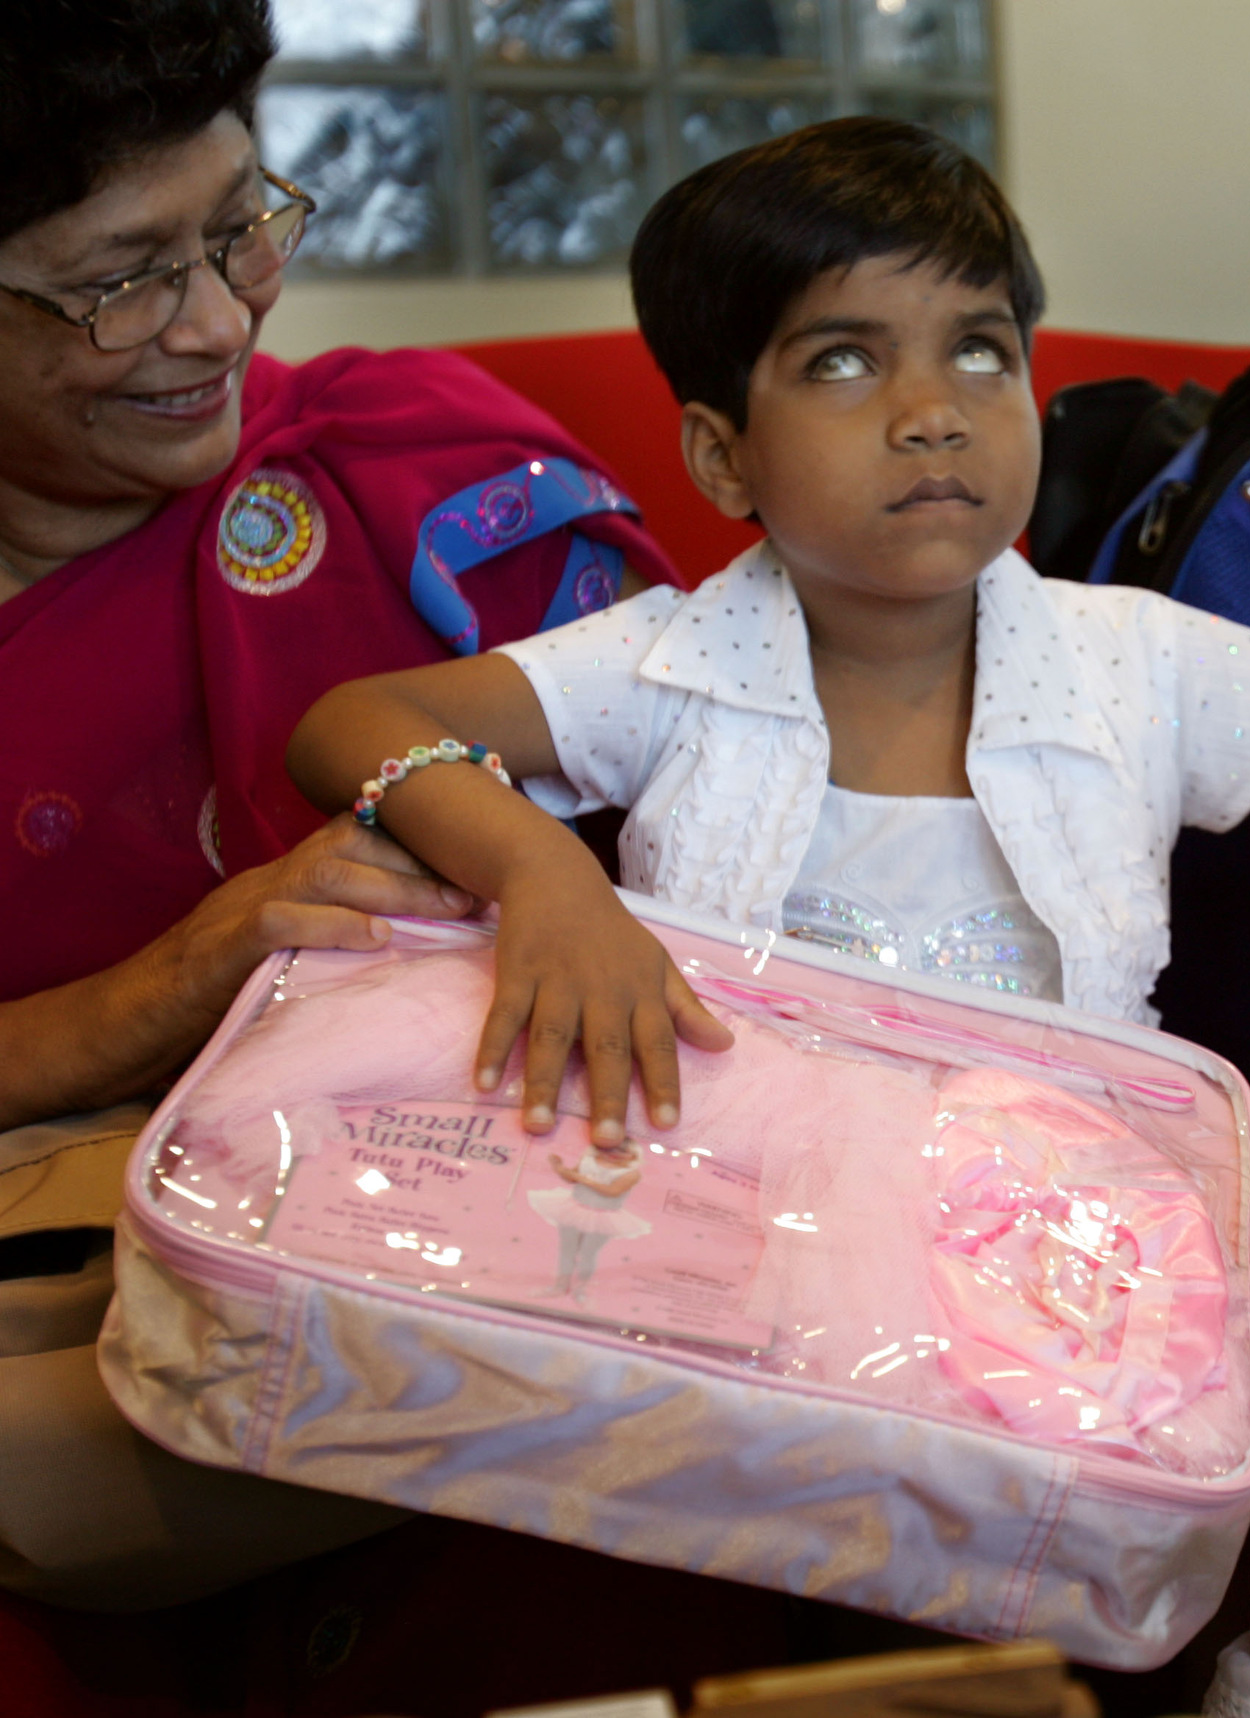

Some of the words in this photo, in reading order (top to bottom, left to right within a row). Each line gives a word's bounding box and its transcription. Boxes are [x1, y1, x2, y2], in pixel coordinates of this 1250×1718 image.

[371, 1106, 494, 1138] Small
[341, 1122, 509, 1165] Miracles
[351, 1148, 404, 1169] Tutu
[416, 1157, 468, 1183] Play
[384, 1170, 422, 1191] Set
